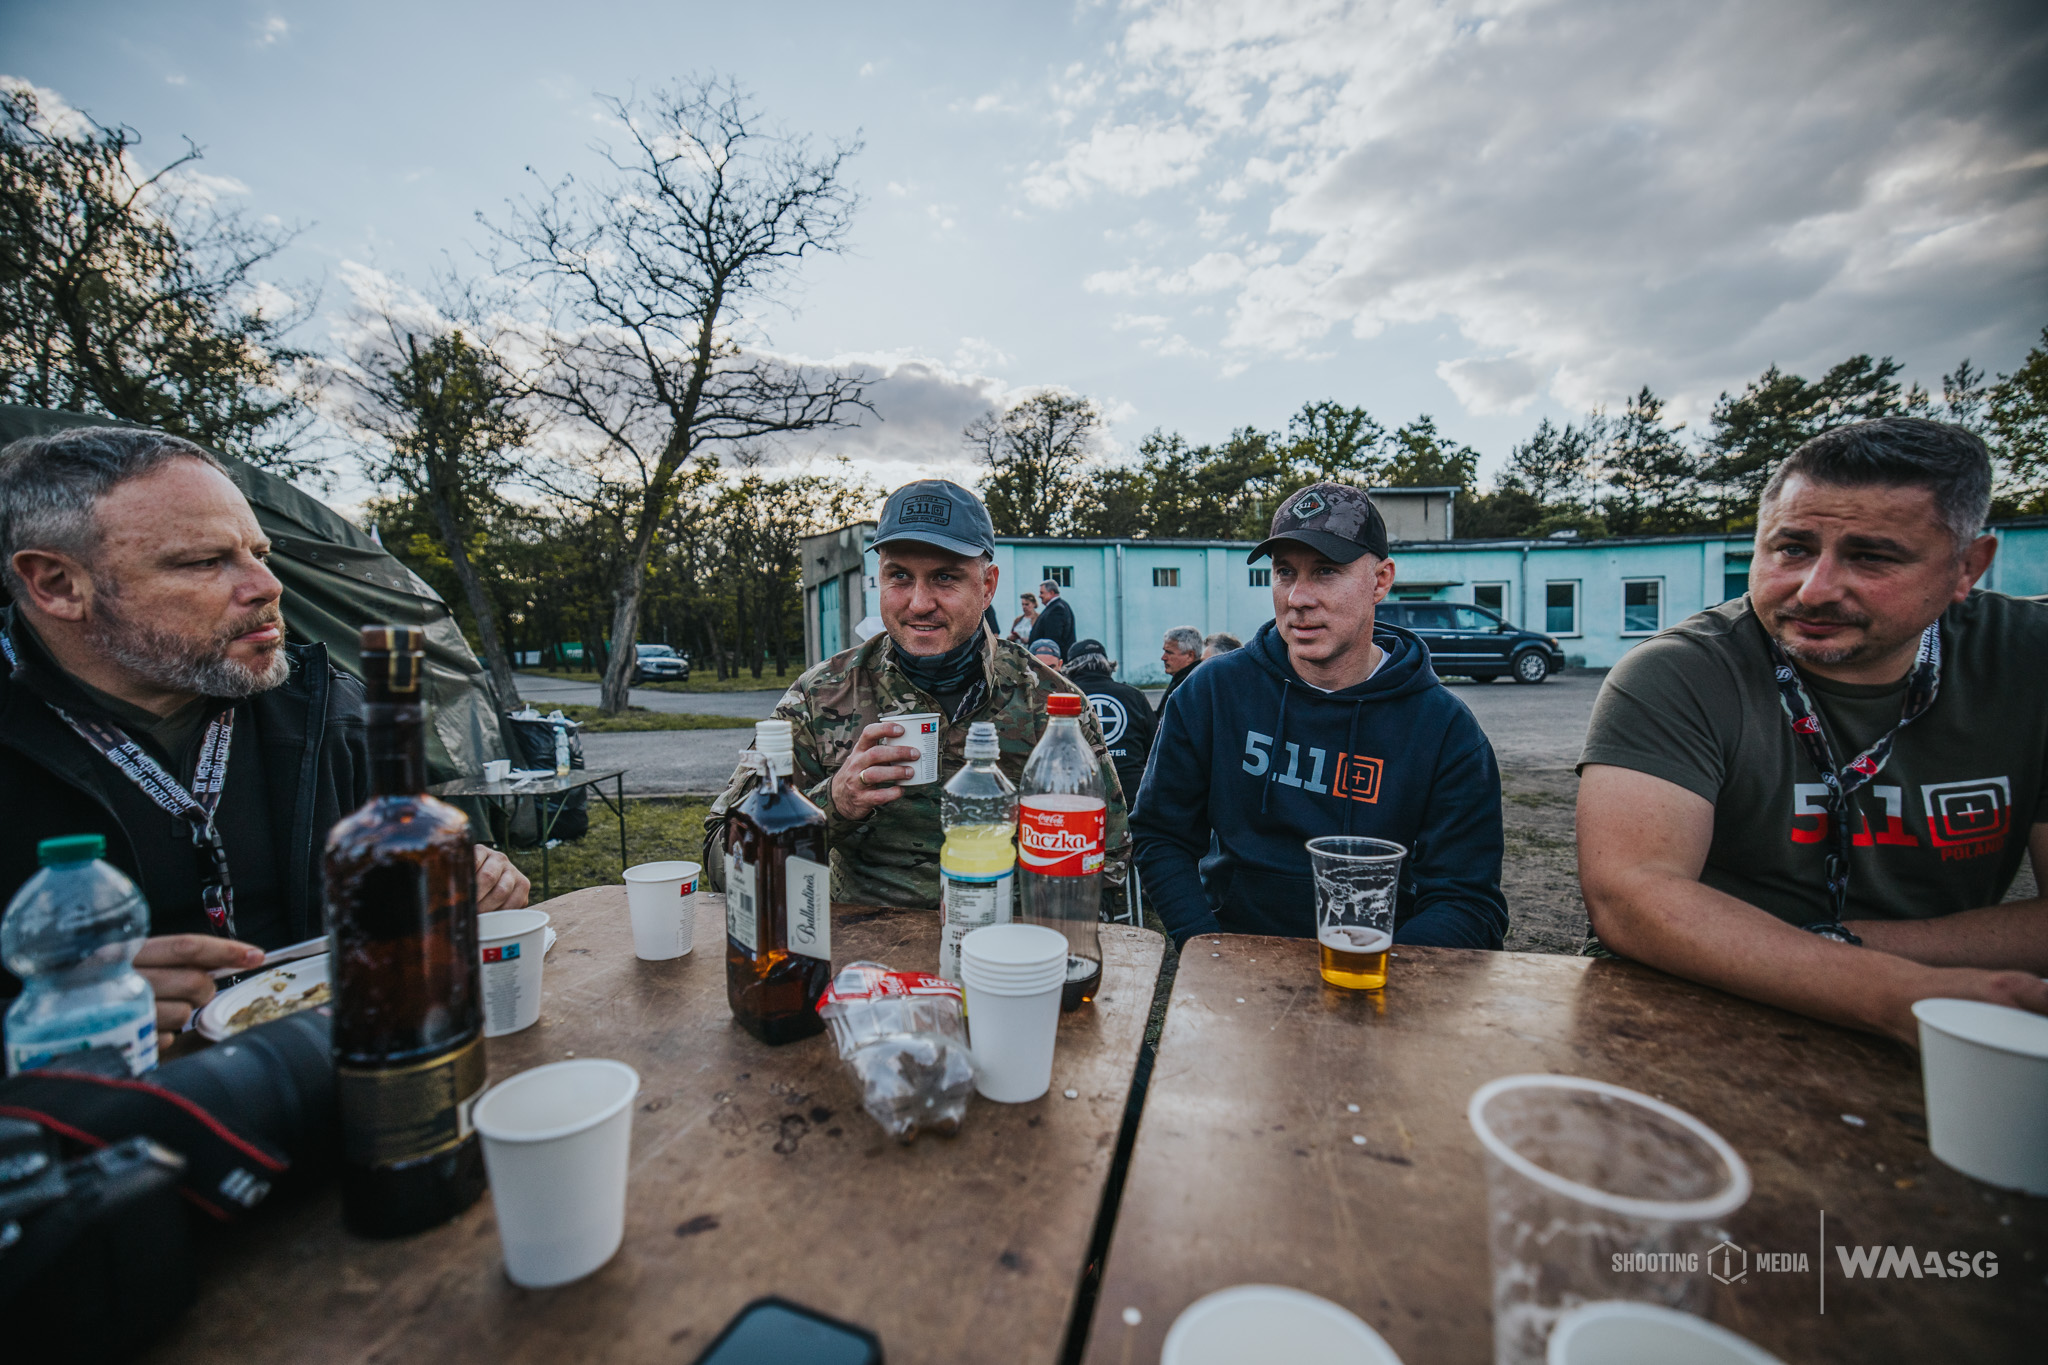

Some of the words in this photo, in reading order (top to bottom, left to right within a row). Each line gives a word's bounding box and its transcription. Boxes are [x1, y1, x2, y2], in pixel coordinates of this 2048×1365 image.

[906, 503, 930, 515] 5.11
[869, 576, 877, 588] 1
[119, 740, 141, 756] XIX
[1242, 730, 1327, 794] 5.11
[140, 779, 184, 816] STRZELECKI
[1022, 824, 1086, 851] Paczka
[796, 873, 817, 944] Ballantine's
